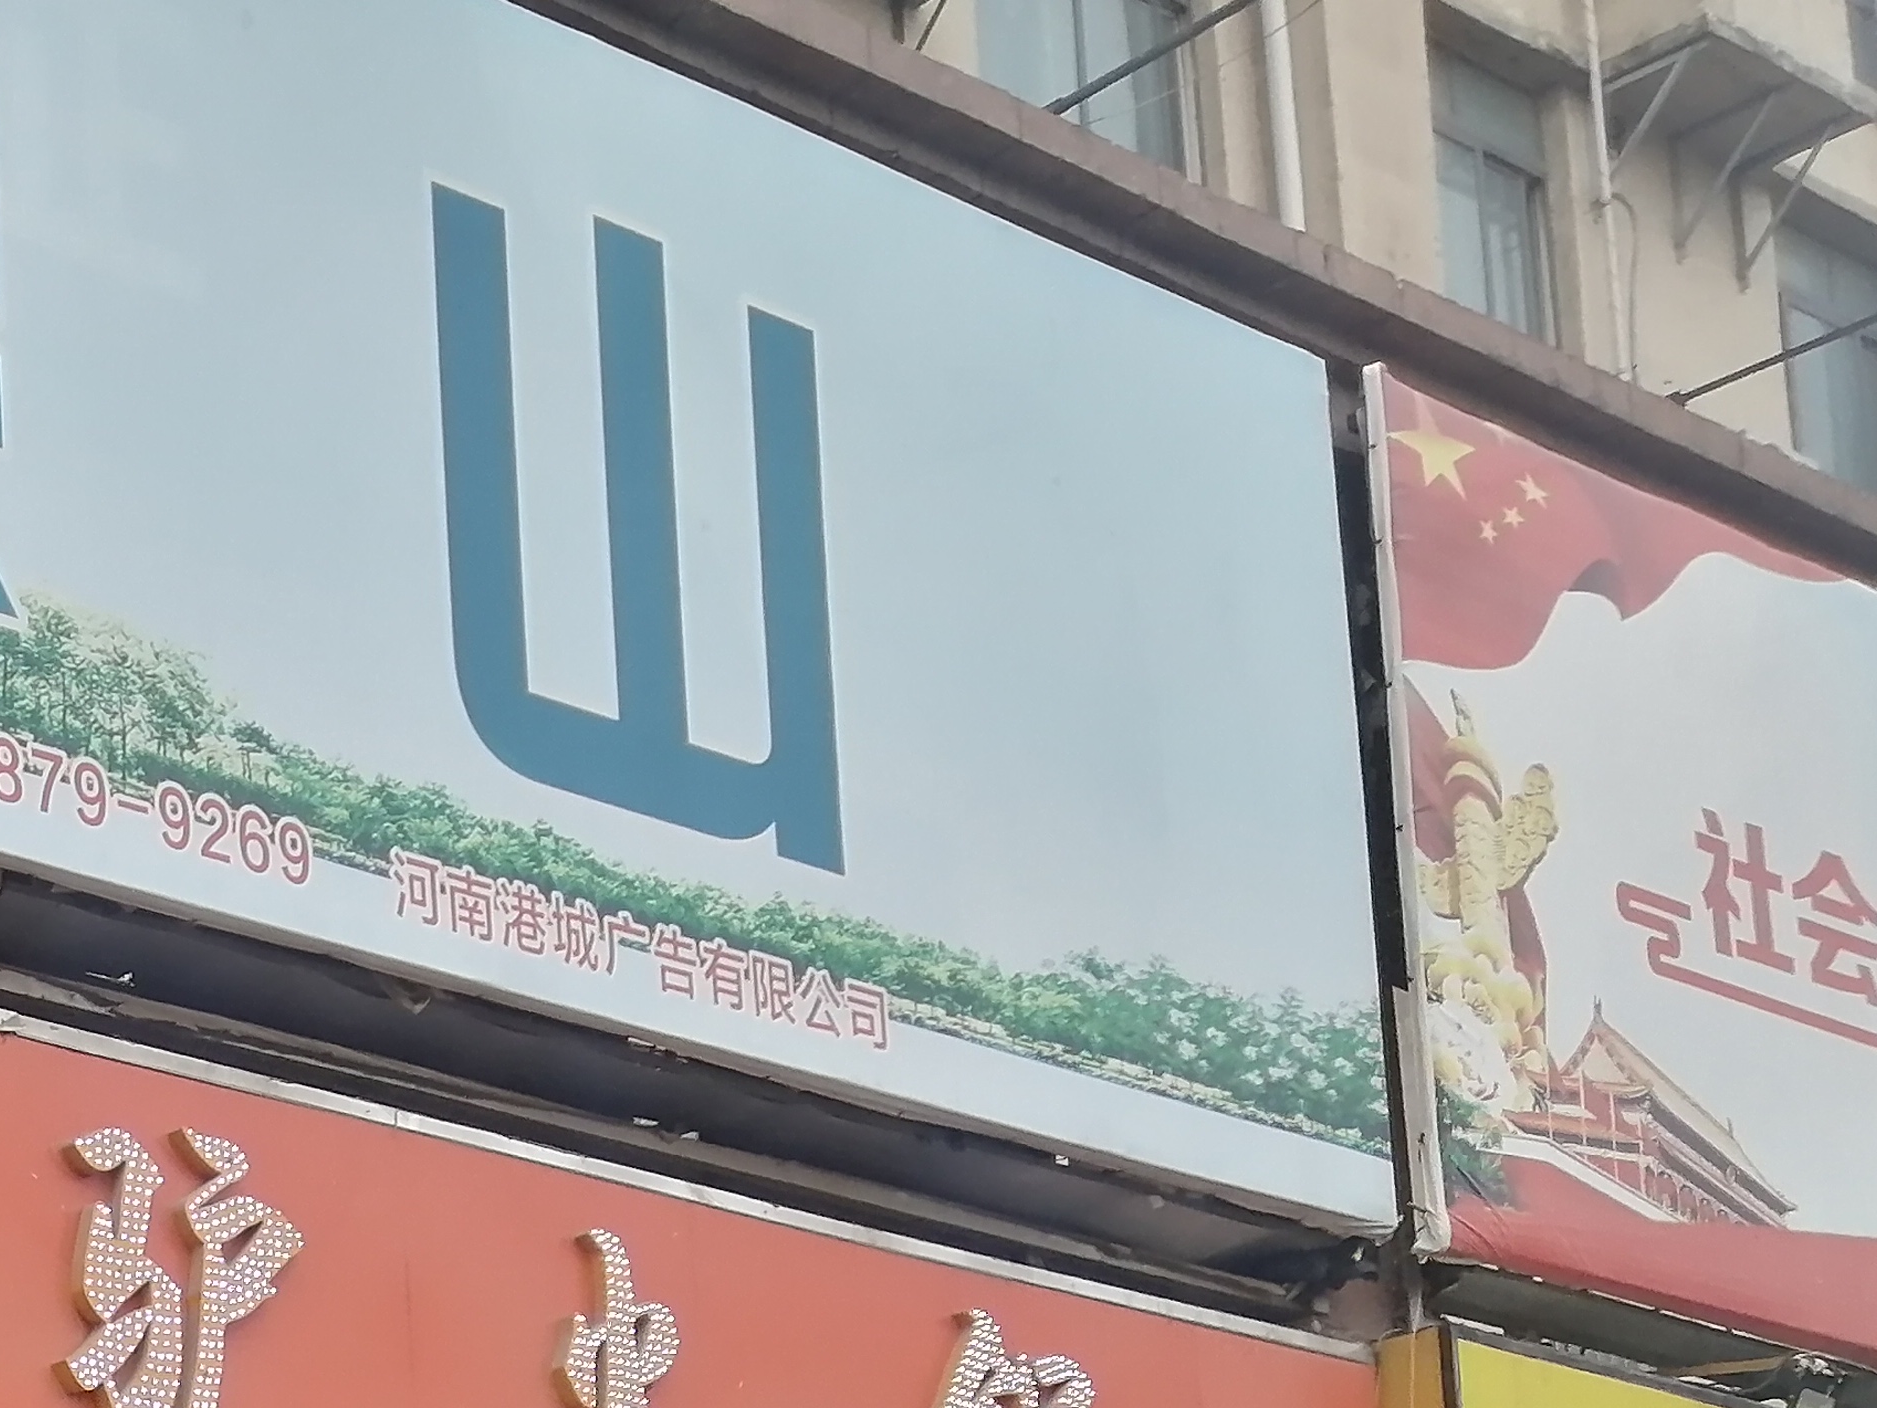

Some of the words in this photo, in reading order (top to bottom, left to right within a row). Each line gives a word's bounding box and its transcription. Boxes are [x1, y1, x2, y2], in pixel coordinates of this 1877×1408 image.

[388, 846, 891, 1054] 河南港城广告有限公司
